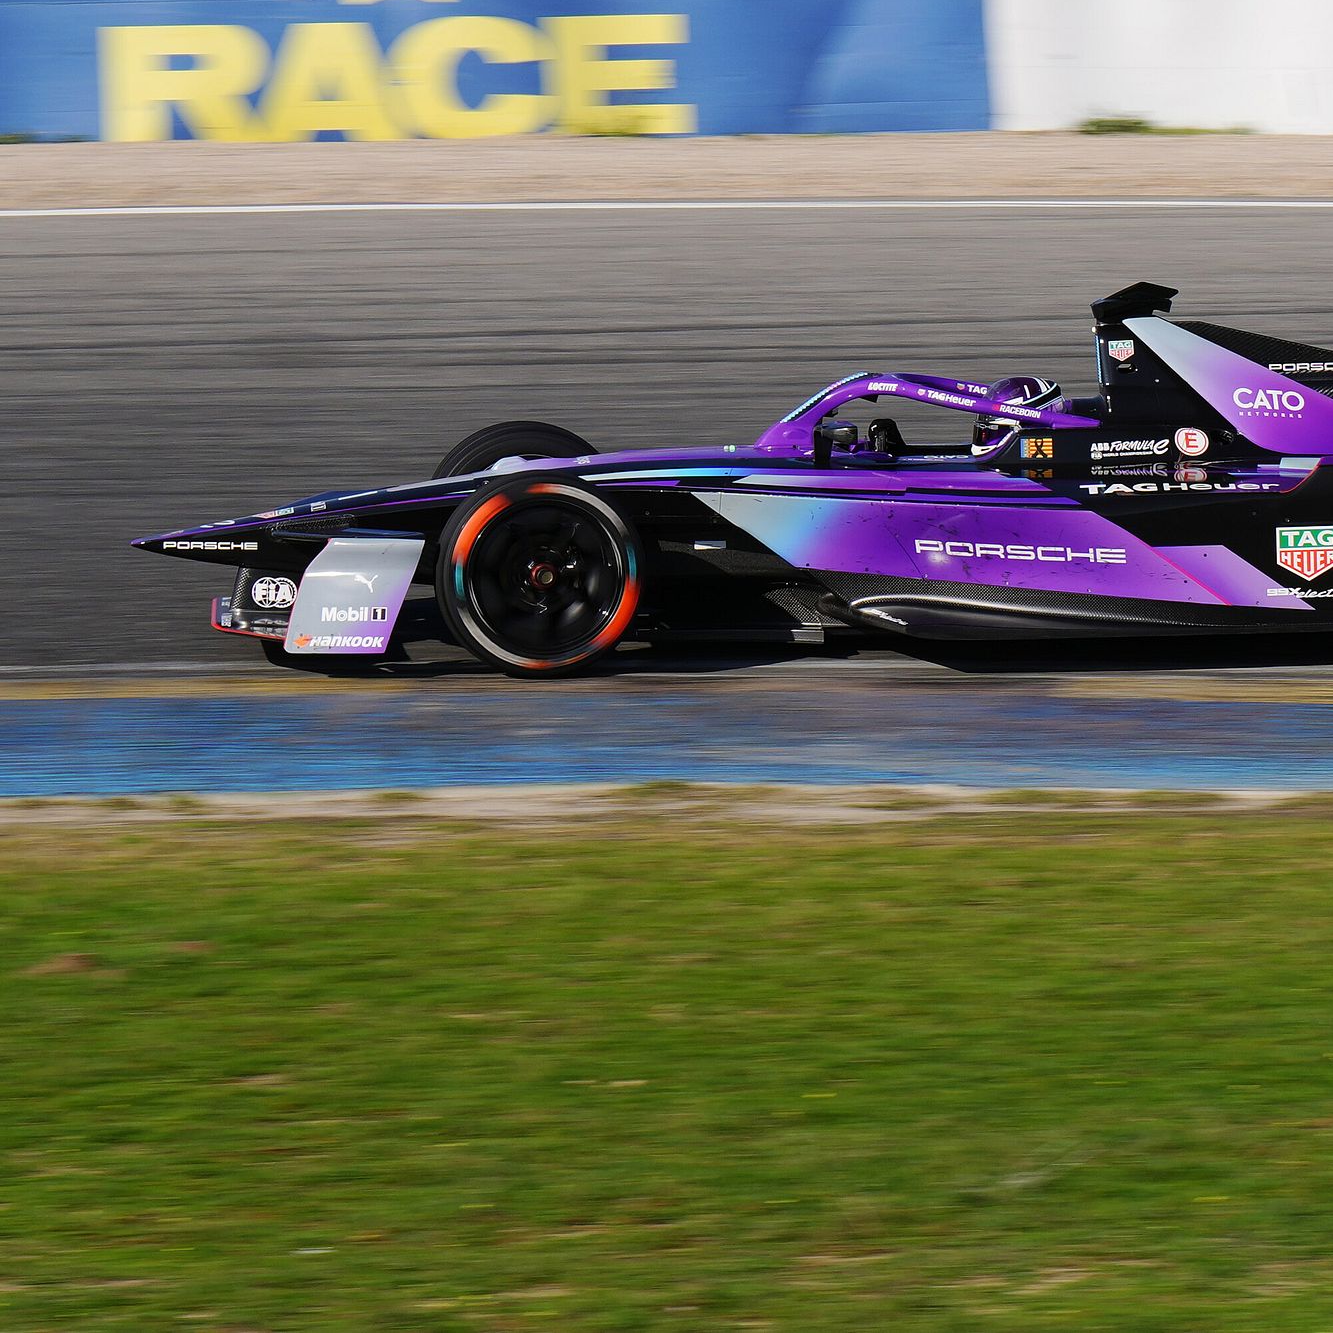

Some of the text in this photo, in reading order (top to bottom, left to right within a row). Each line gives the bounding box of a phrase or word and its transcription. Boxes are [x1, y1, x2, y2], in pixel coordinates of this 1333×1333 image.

[101, 14, 697, 142] RACE
[1111, 341, 1133, 349] TAG
[1233, 387, 1305, 412] CATO
[1000, 403, 1042, 419] RACEBORN
[1239, 411, 1303, 419] NETWORKS
[162, 541, 258, 551] PORSCHE
[914, 539, 1127, 564] PORSCHE
[321, 606, 368, 622] Mobil
